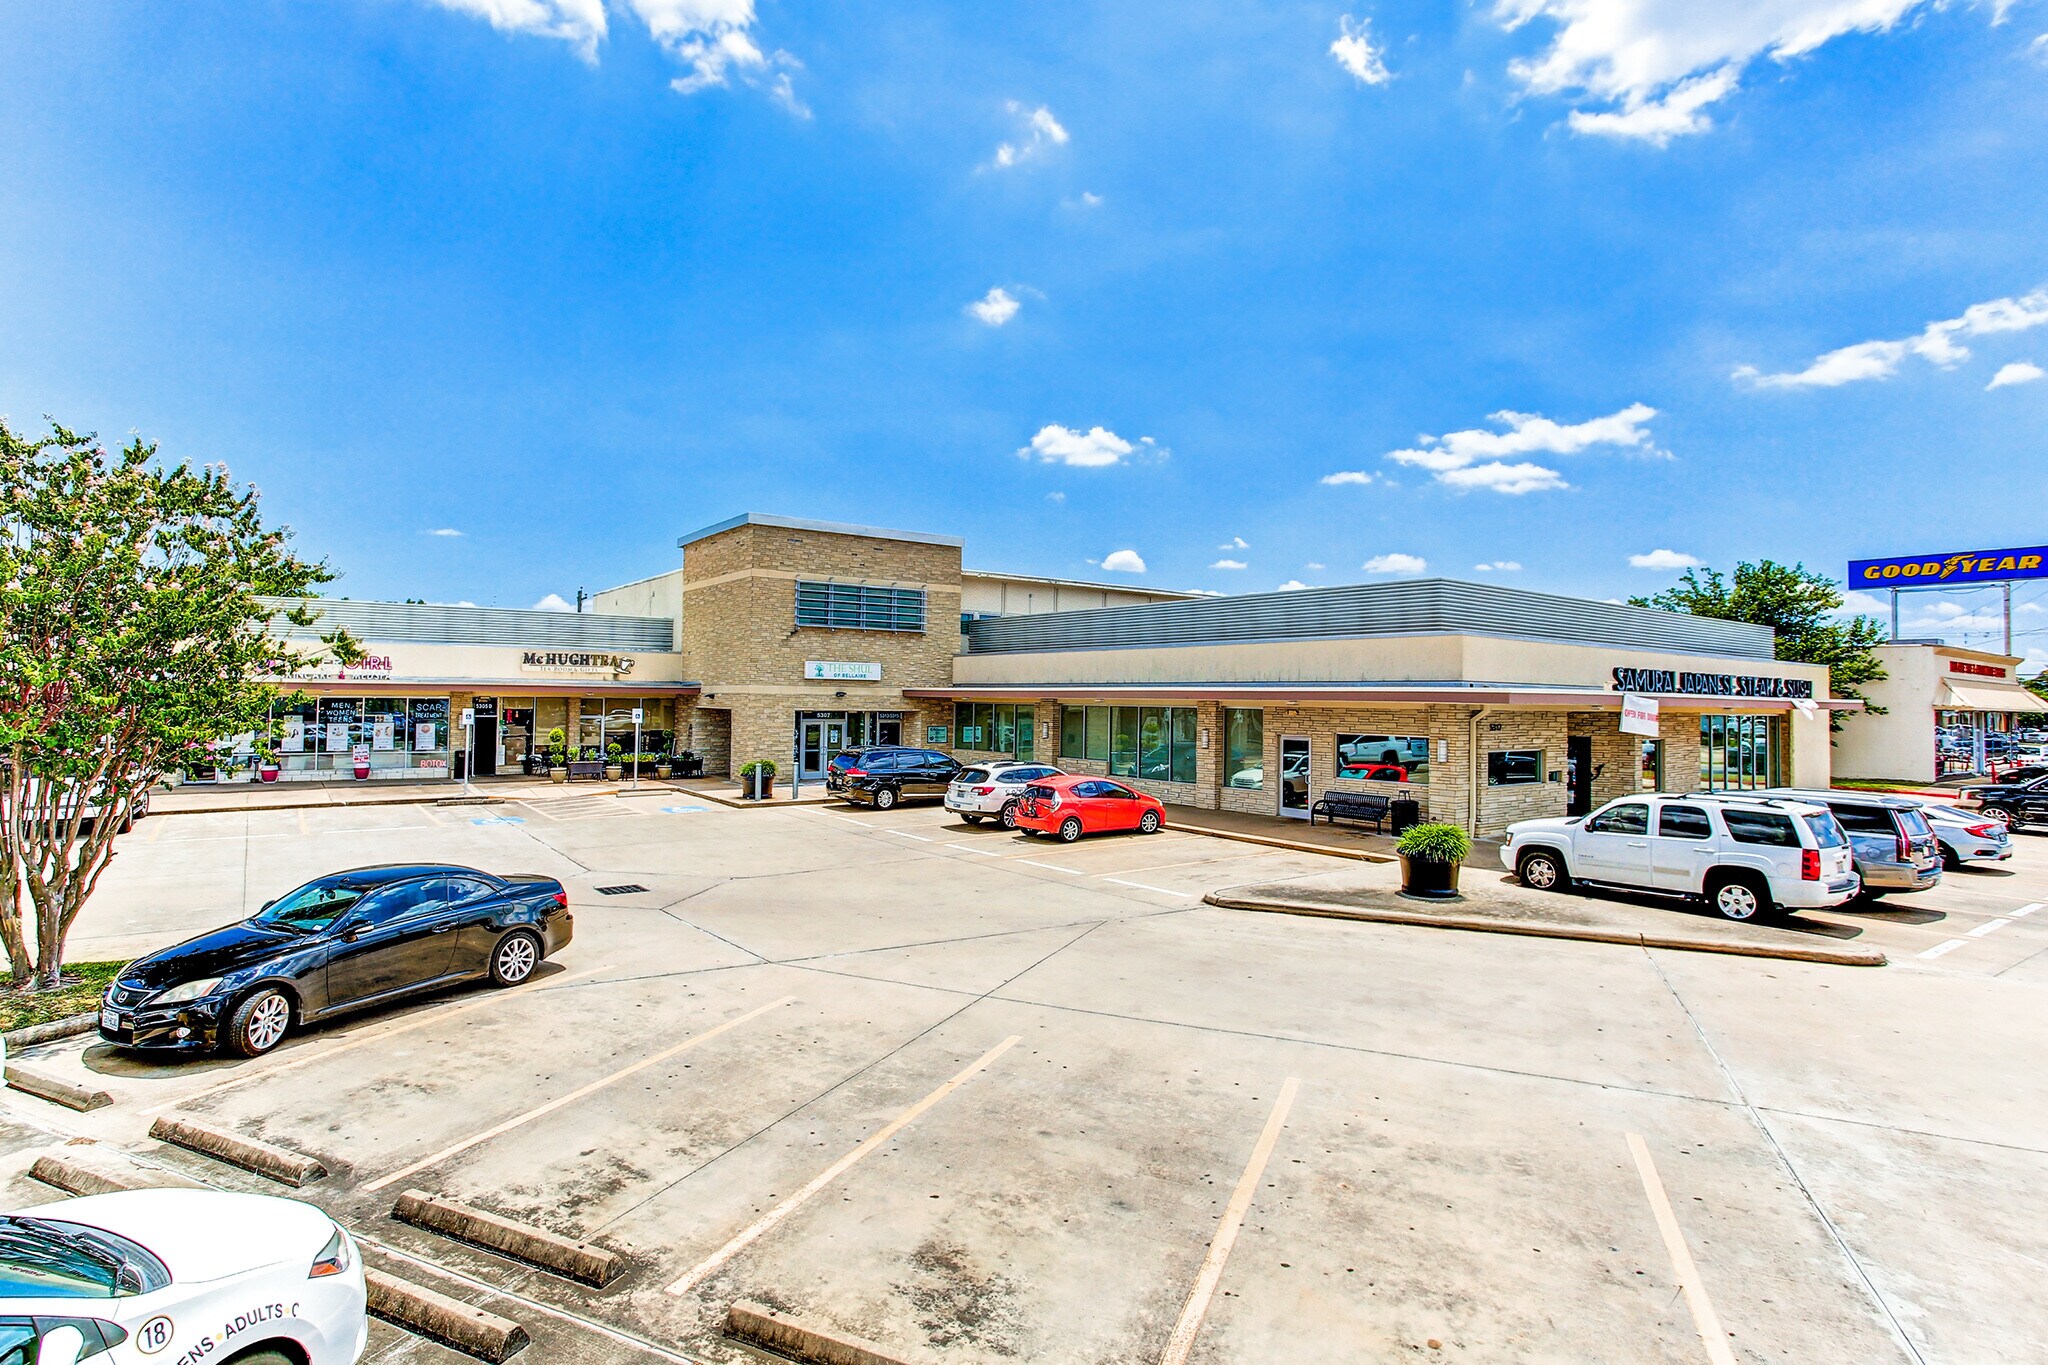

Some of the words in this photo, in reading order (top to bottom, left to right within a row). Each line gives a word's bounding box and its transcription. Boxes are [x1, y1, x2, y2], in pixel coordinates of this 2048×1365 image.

[827, 664, 847, 673] THE
[848, 664, 873, 674] SHUL
[415, 703, 443, 712] SCAR
[420, 759, 447, 768] BOTOX
[225, 1303, 283, 1340] ADULTS
[144, 1321, 165, 1348] 18
